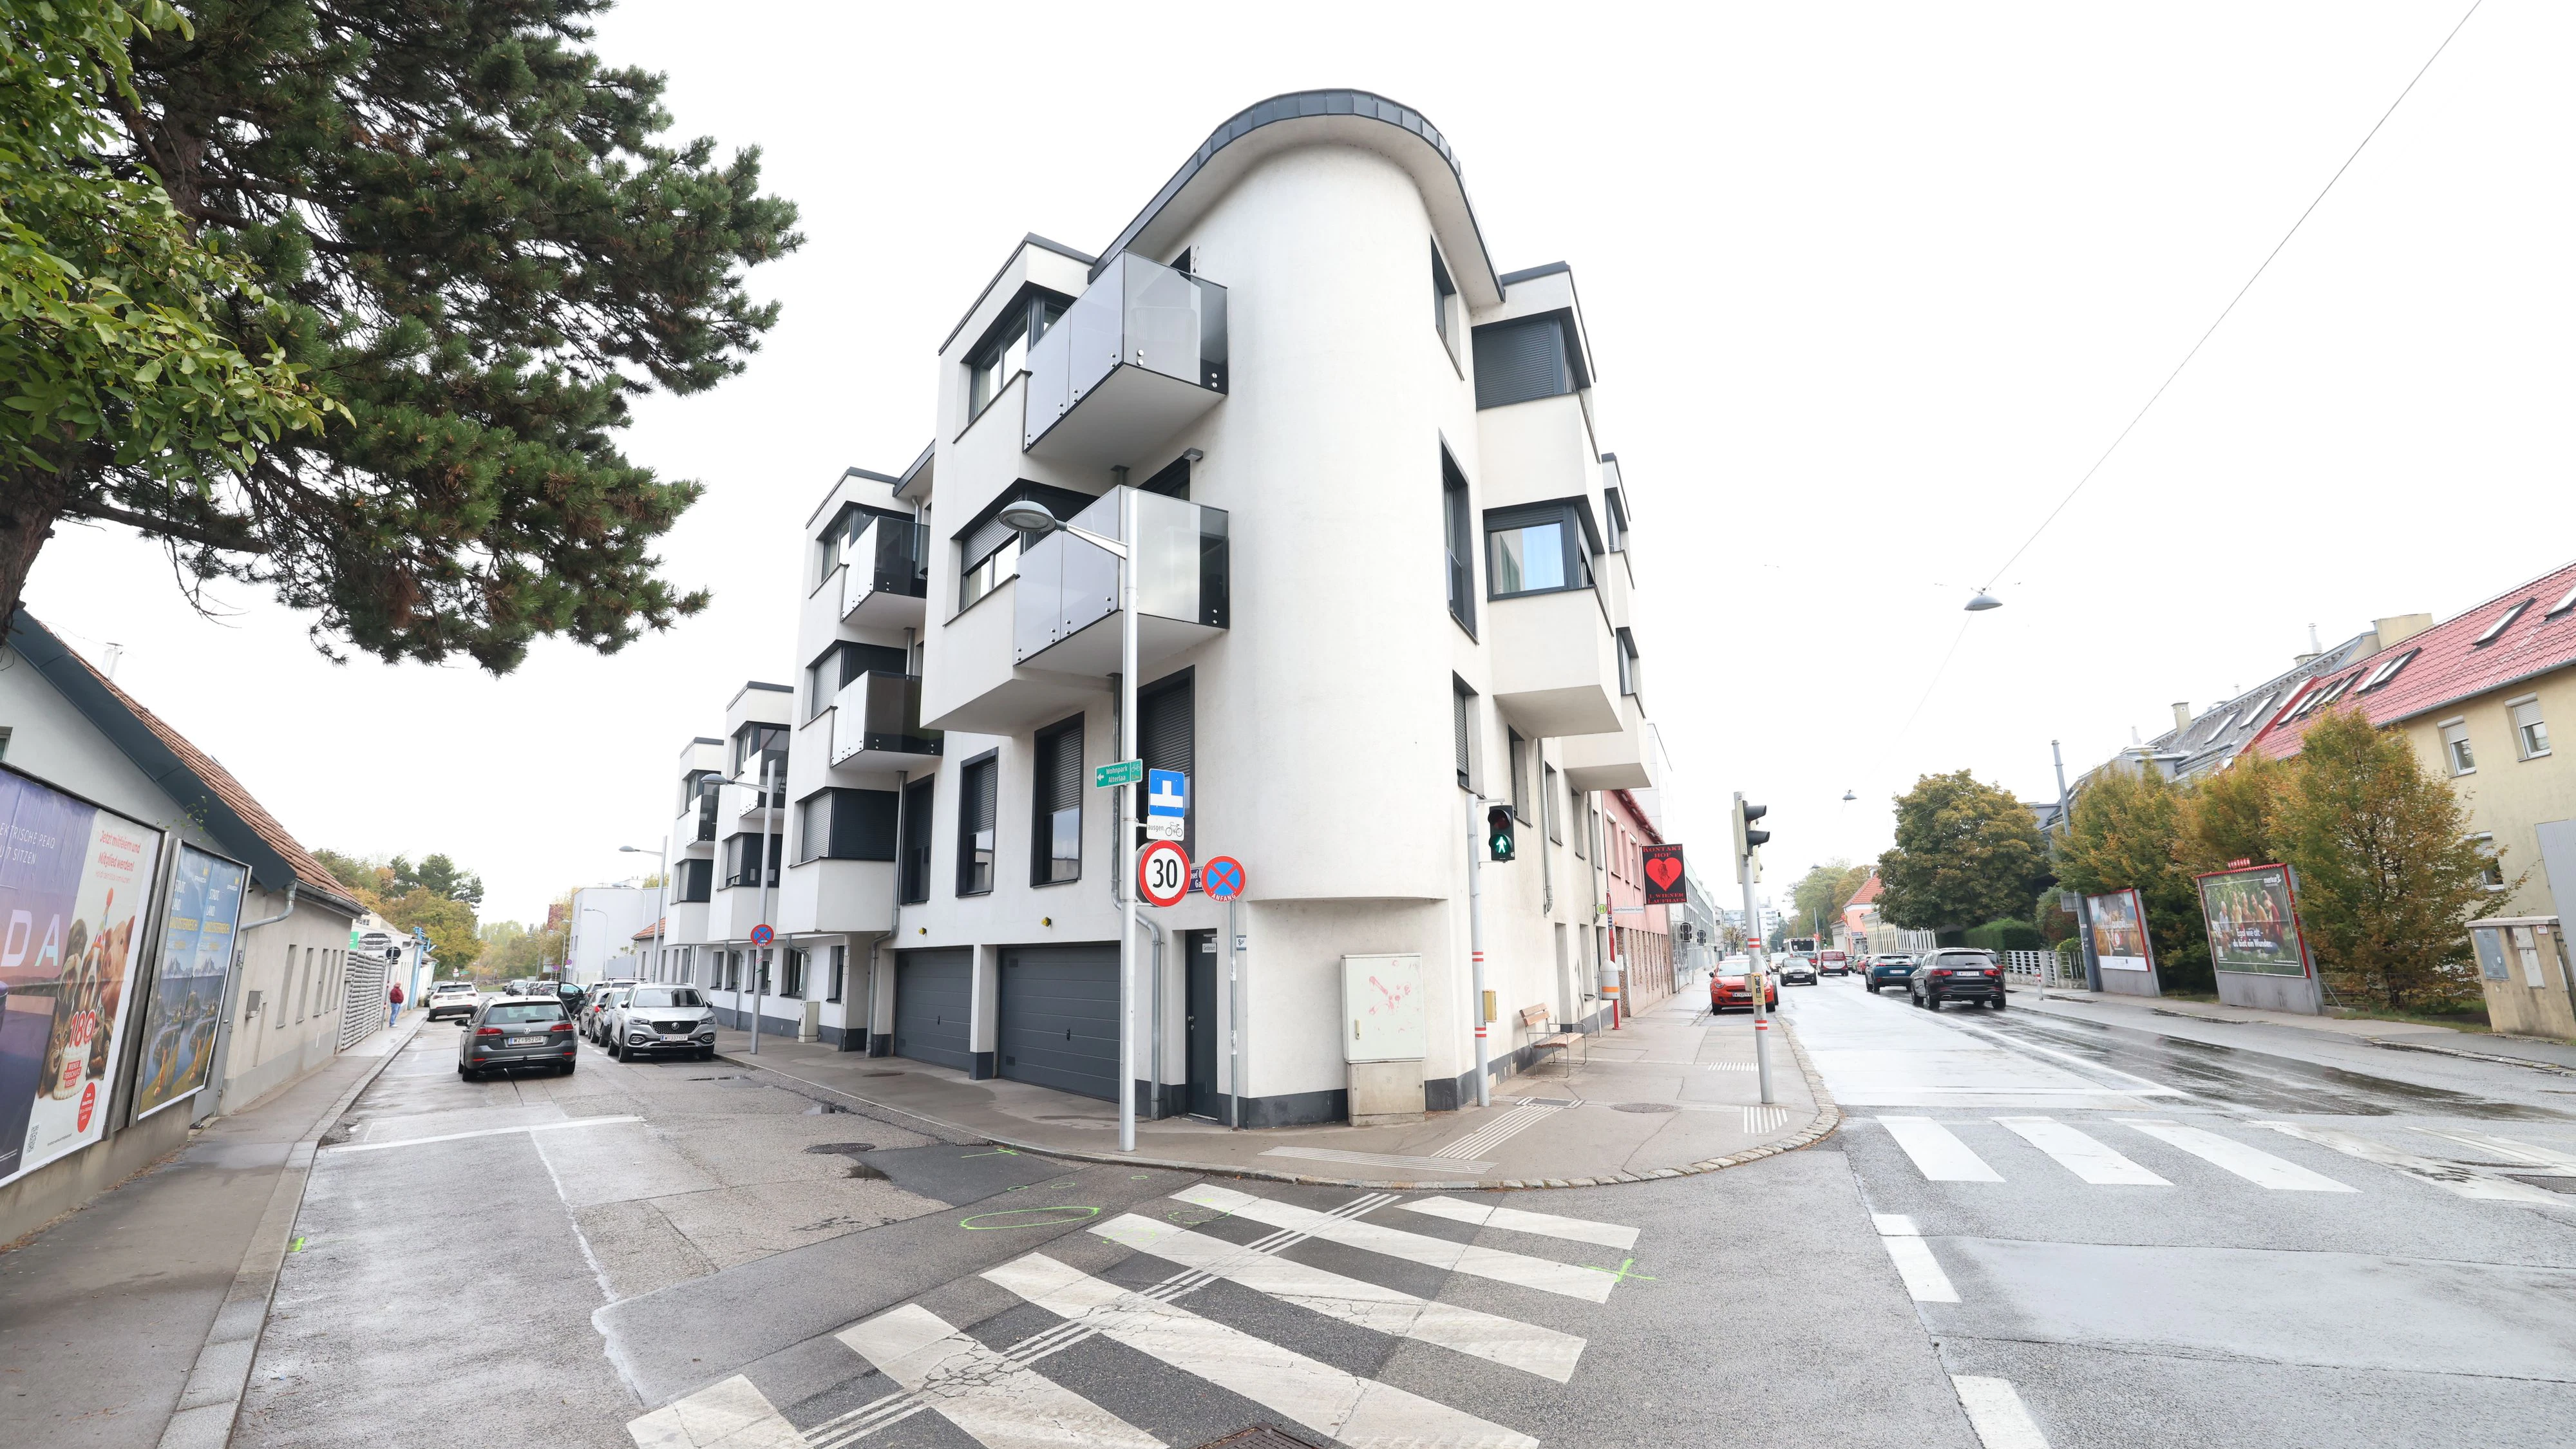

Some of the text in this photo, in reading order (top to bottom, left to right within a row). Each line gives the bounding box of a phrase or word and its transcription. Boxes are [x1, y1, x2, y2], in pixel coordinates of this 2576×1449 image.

[1106, 765, 1128, 775] Wohnpark
[131, 842, 142, 854] und
[12, 848, 37, 864] SITZEN
[1152, 858, 1178, 889] 30
[209, 889, 220, 901] STADT.
[1211, 893, 1236, 902] ANFANG
[206, 904, 216, 917] LAND.
[2236, 928, 2246, 938] Egal
[2233, 939, 2238, 947] du
[2238, 939, 2248, 947] bist
[2255, 938, 2273, 947] Wunder.
[69, 1010, 95, 1048] 180
[65, 1079, 75, 1087] VEREIN
